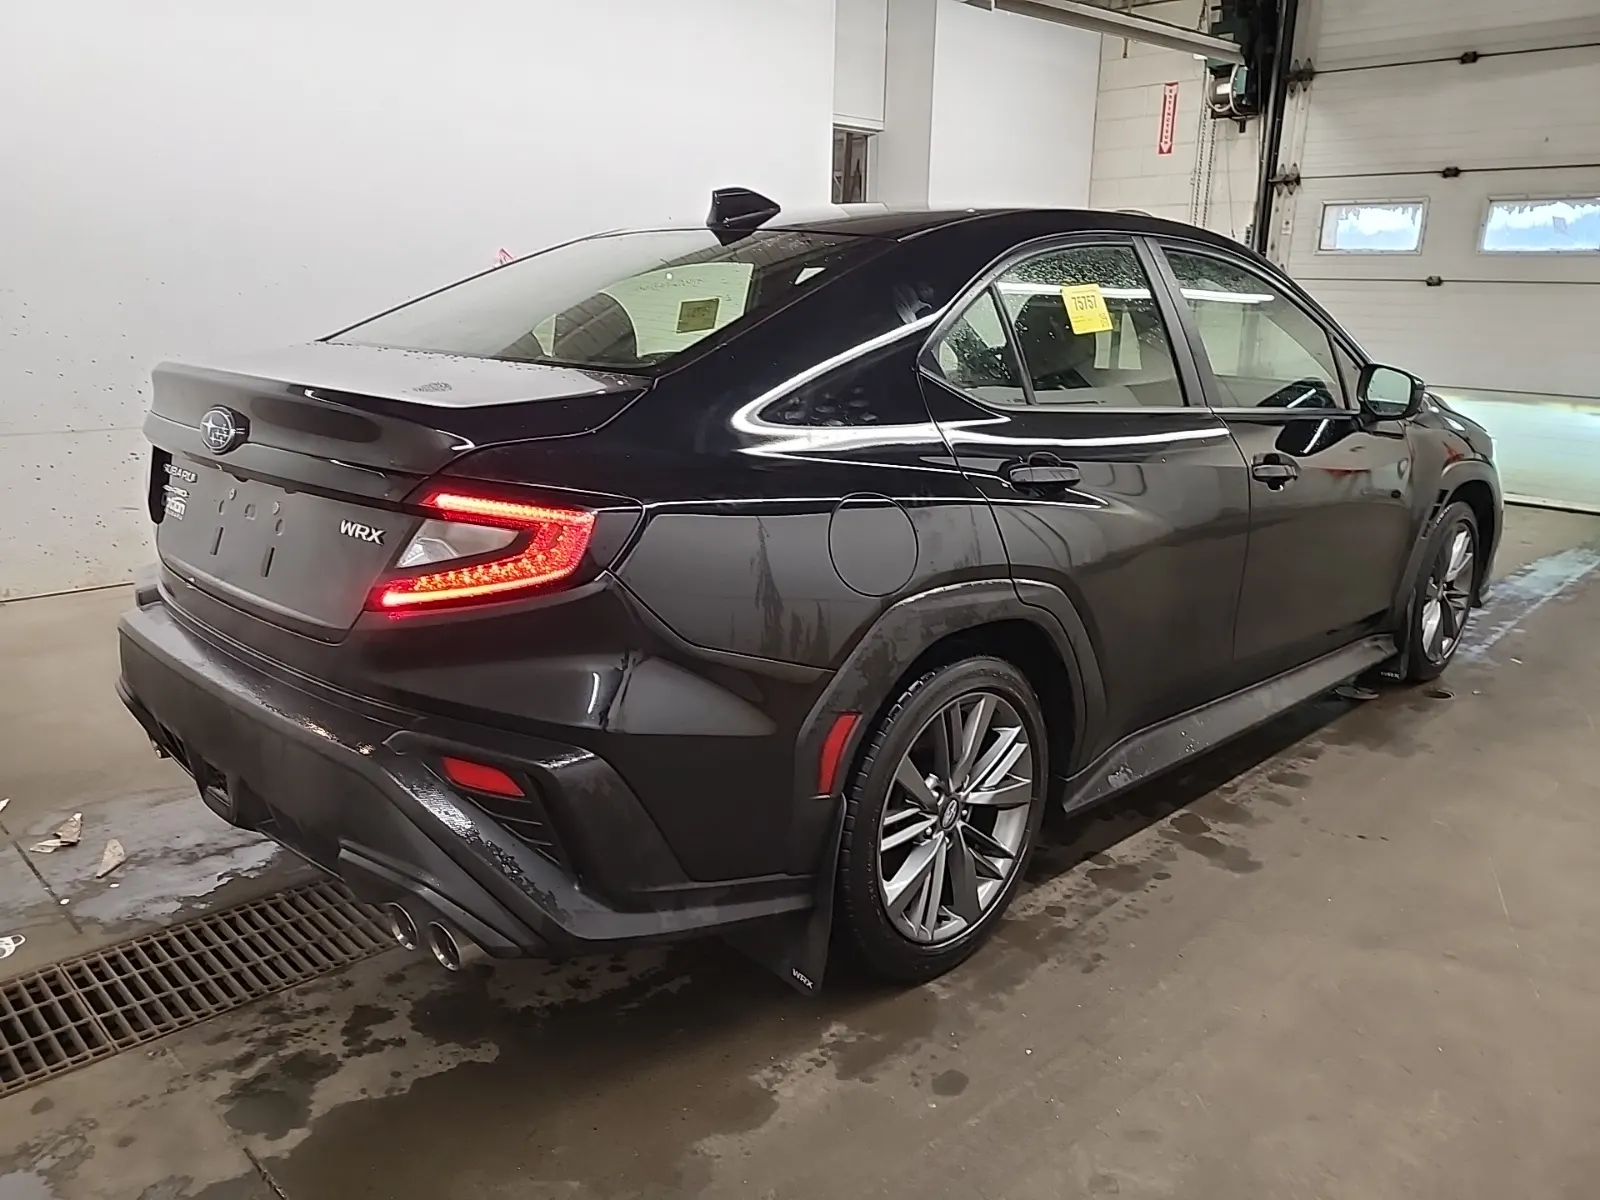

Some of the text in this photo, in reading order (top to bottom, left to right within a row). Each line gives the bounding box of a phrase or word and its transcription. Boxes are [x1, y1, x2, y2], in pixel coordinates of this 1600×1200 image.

[1071, 294, 1098, 311] 75757
[340, 519, 385, 546] WRX
[792, 967, 814, 990] WRX
